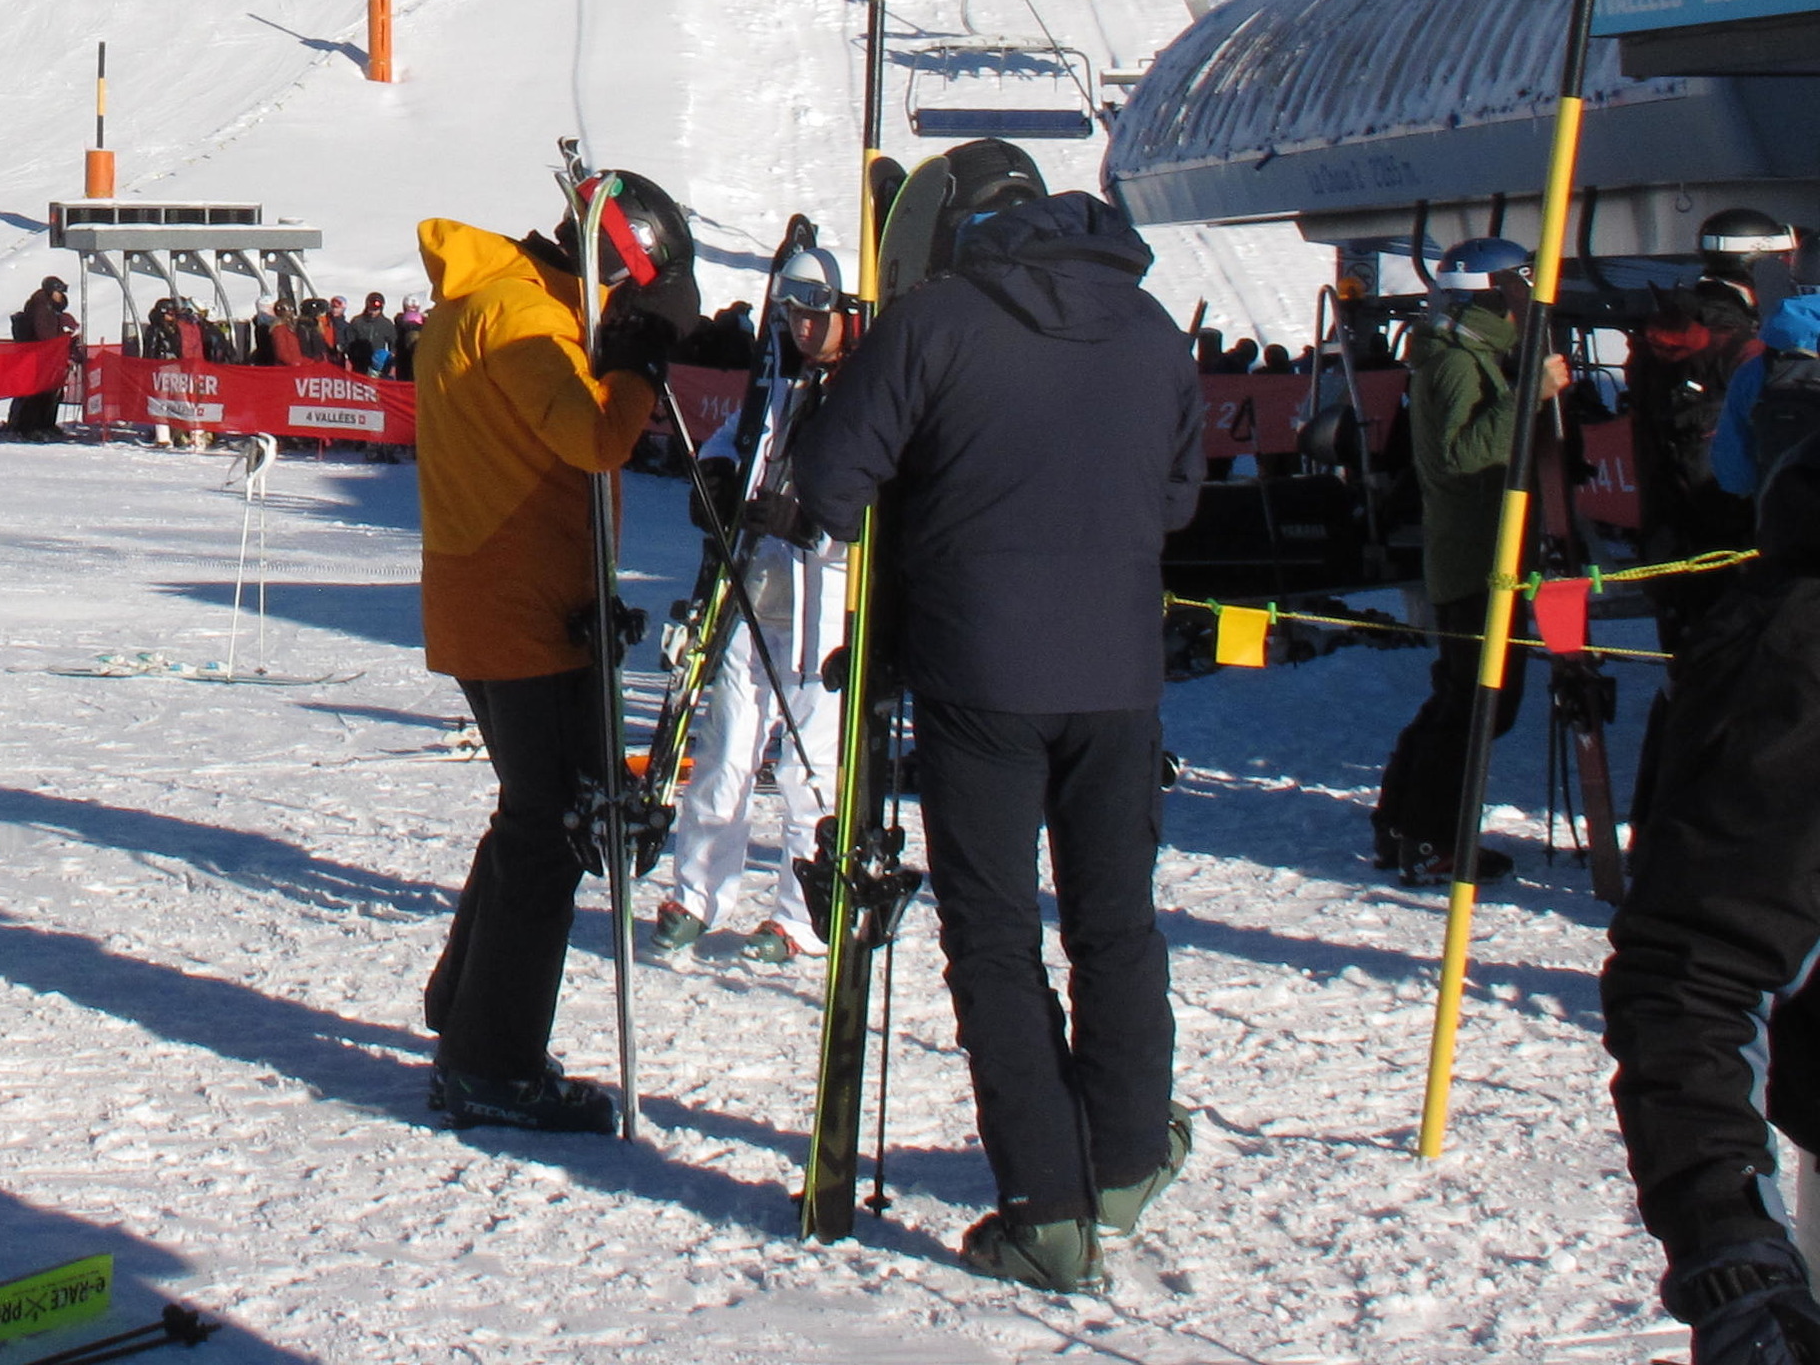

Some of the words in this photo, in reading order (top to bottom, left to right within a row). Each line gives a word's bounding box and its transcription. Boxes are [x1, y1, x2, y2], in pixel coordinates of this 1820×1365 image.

[151, 371, 219, 395] VERBIER
[294, 377, 378, 403] VERBIER
[315, 410, 357, 424] VALLÉES
